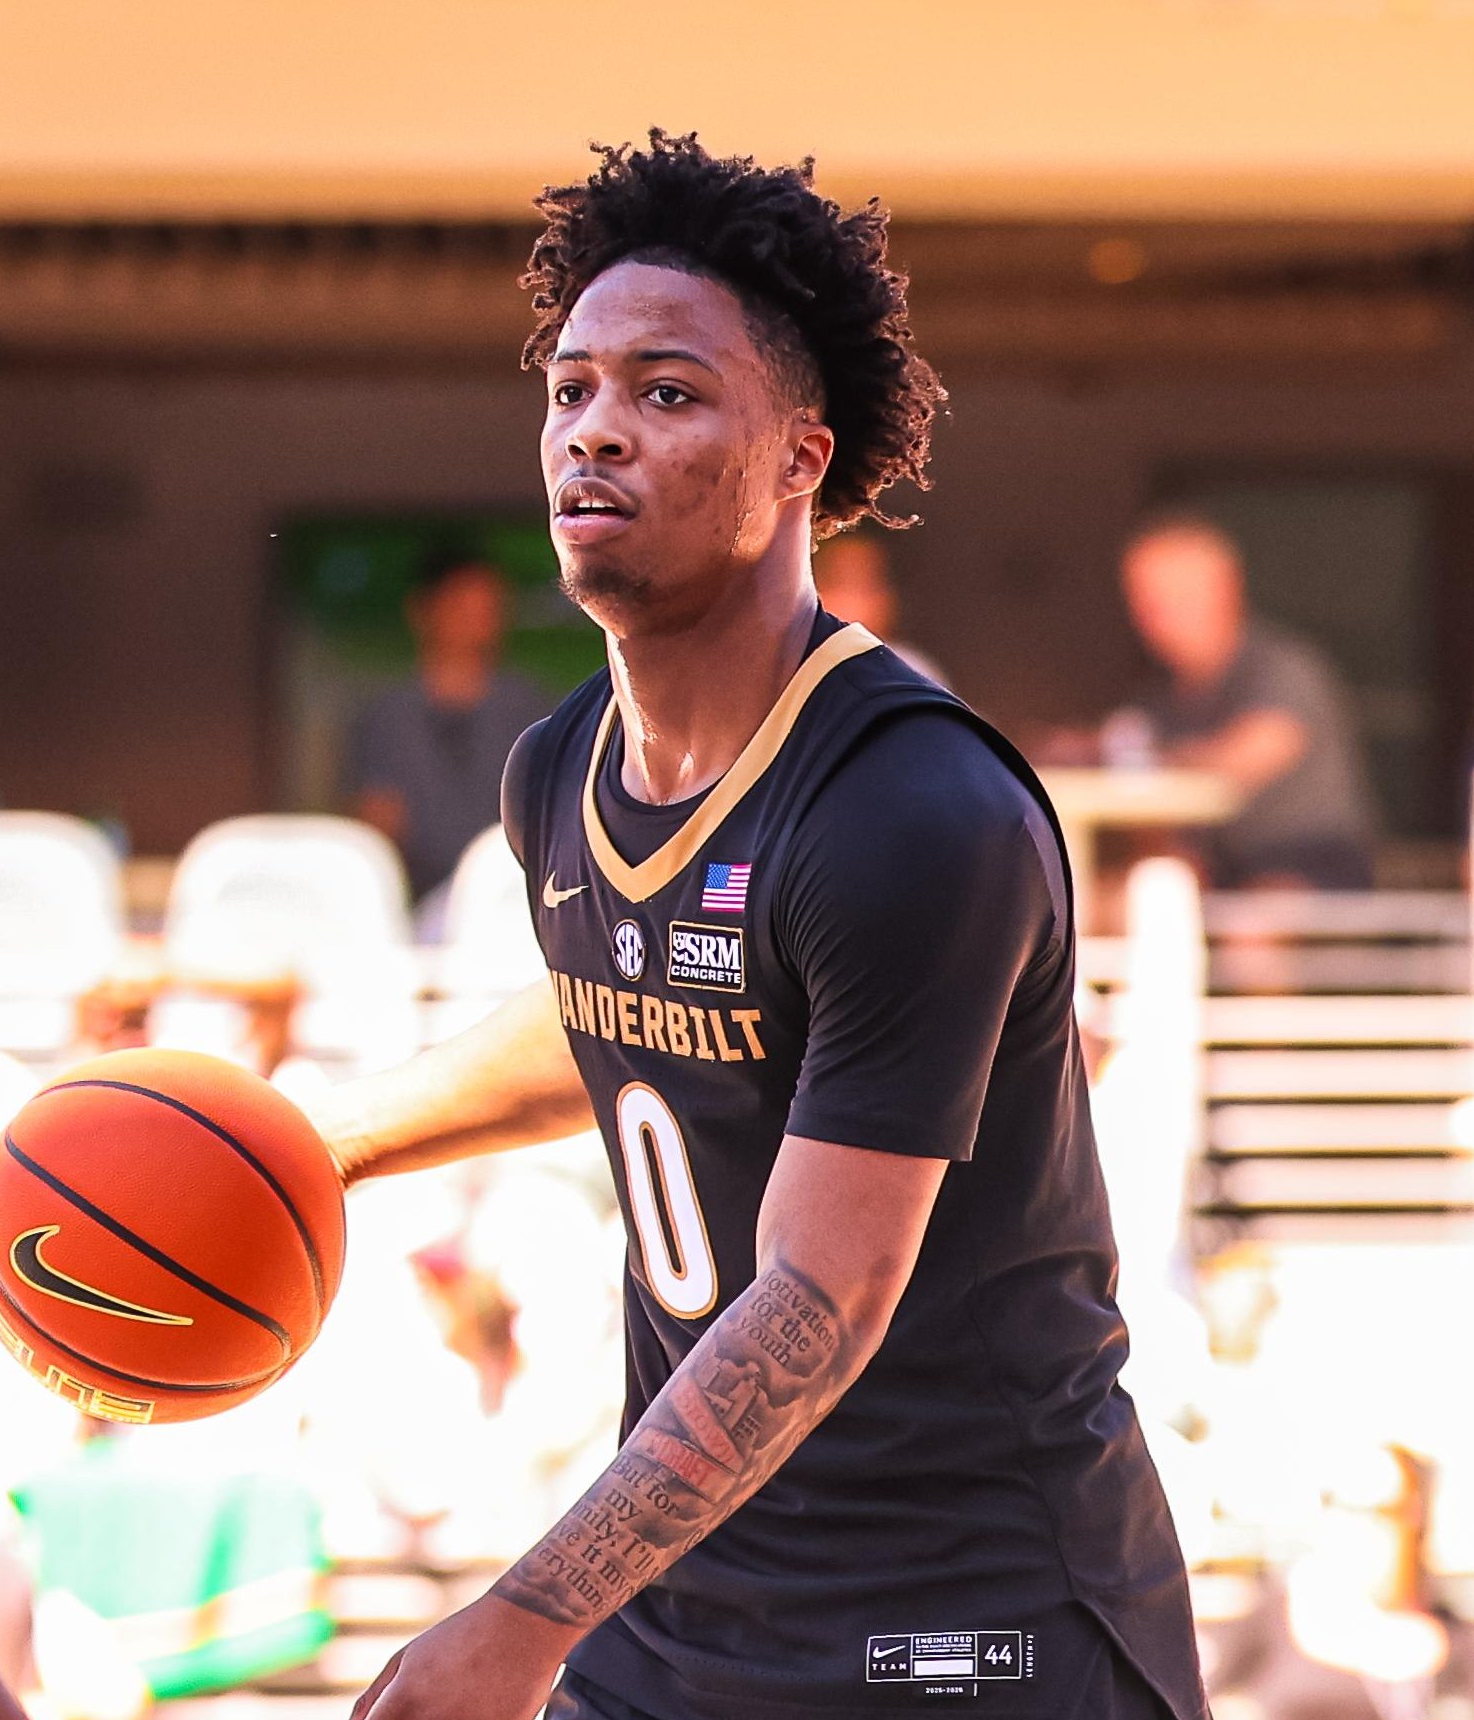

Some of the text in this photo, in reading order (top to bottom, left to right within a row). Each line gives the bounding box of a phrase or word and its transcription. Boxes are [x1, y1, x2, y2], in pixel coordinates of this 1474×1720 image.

[615, 923, 643, 977] SEC
[685, 933, 741, 971] SRM
[670, 965, 742, 984] CONCRETE
[616, 1080, 719, 1320] 0
[733, 1317, 792, 1367] youth
[750, 1291, 811, 1352] for the
[604, 1487, 643, 1522] my
[612, 1453, 643, 1488] But
[645, 1477, 680, 1516] for
[571, 1501, 618, 1547] mily,
[580, 1539, 603, 1564] it
[597, 1561, 629, 1594] my
[915, 1636, 973, 1645] ENGINEERED
[984, 1644, 1013, 1666] 44
[871, 1662, 908, 1671] TEAM
